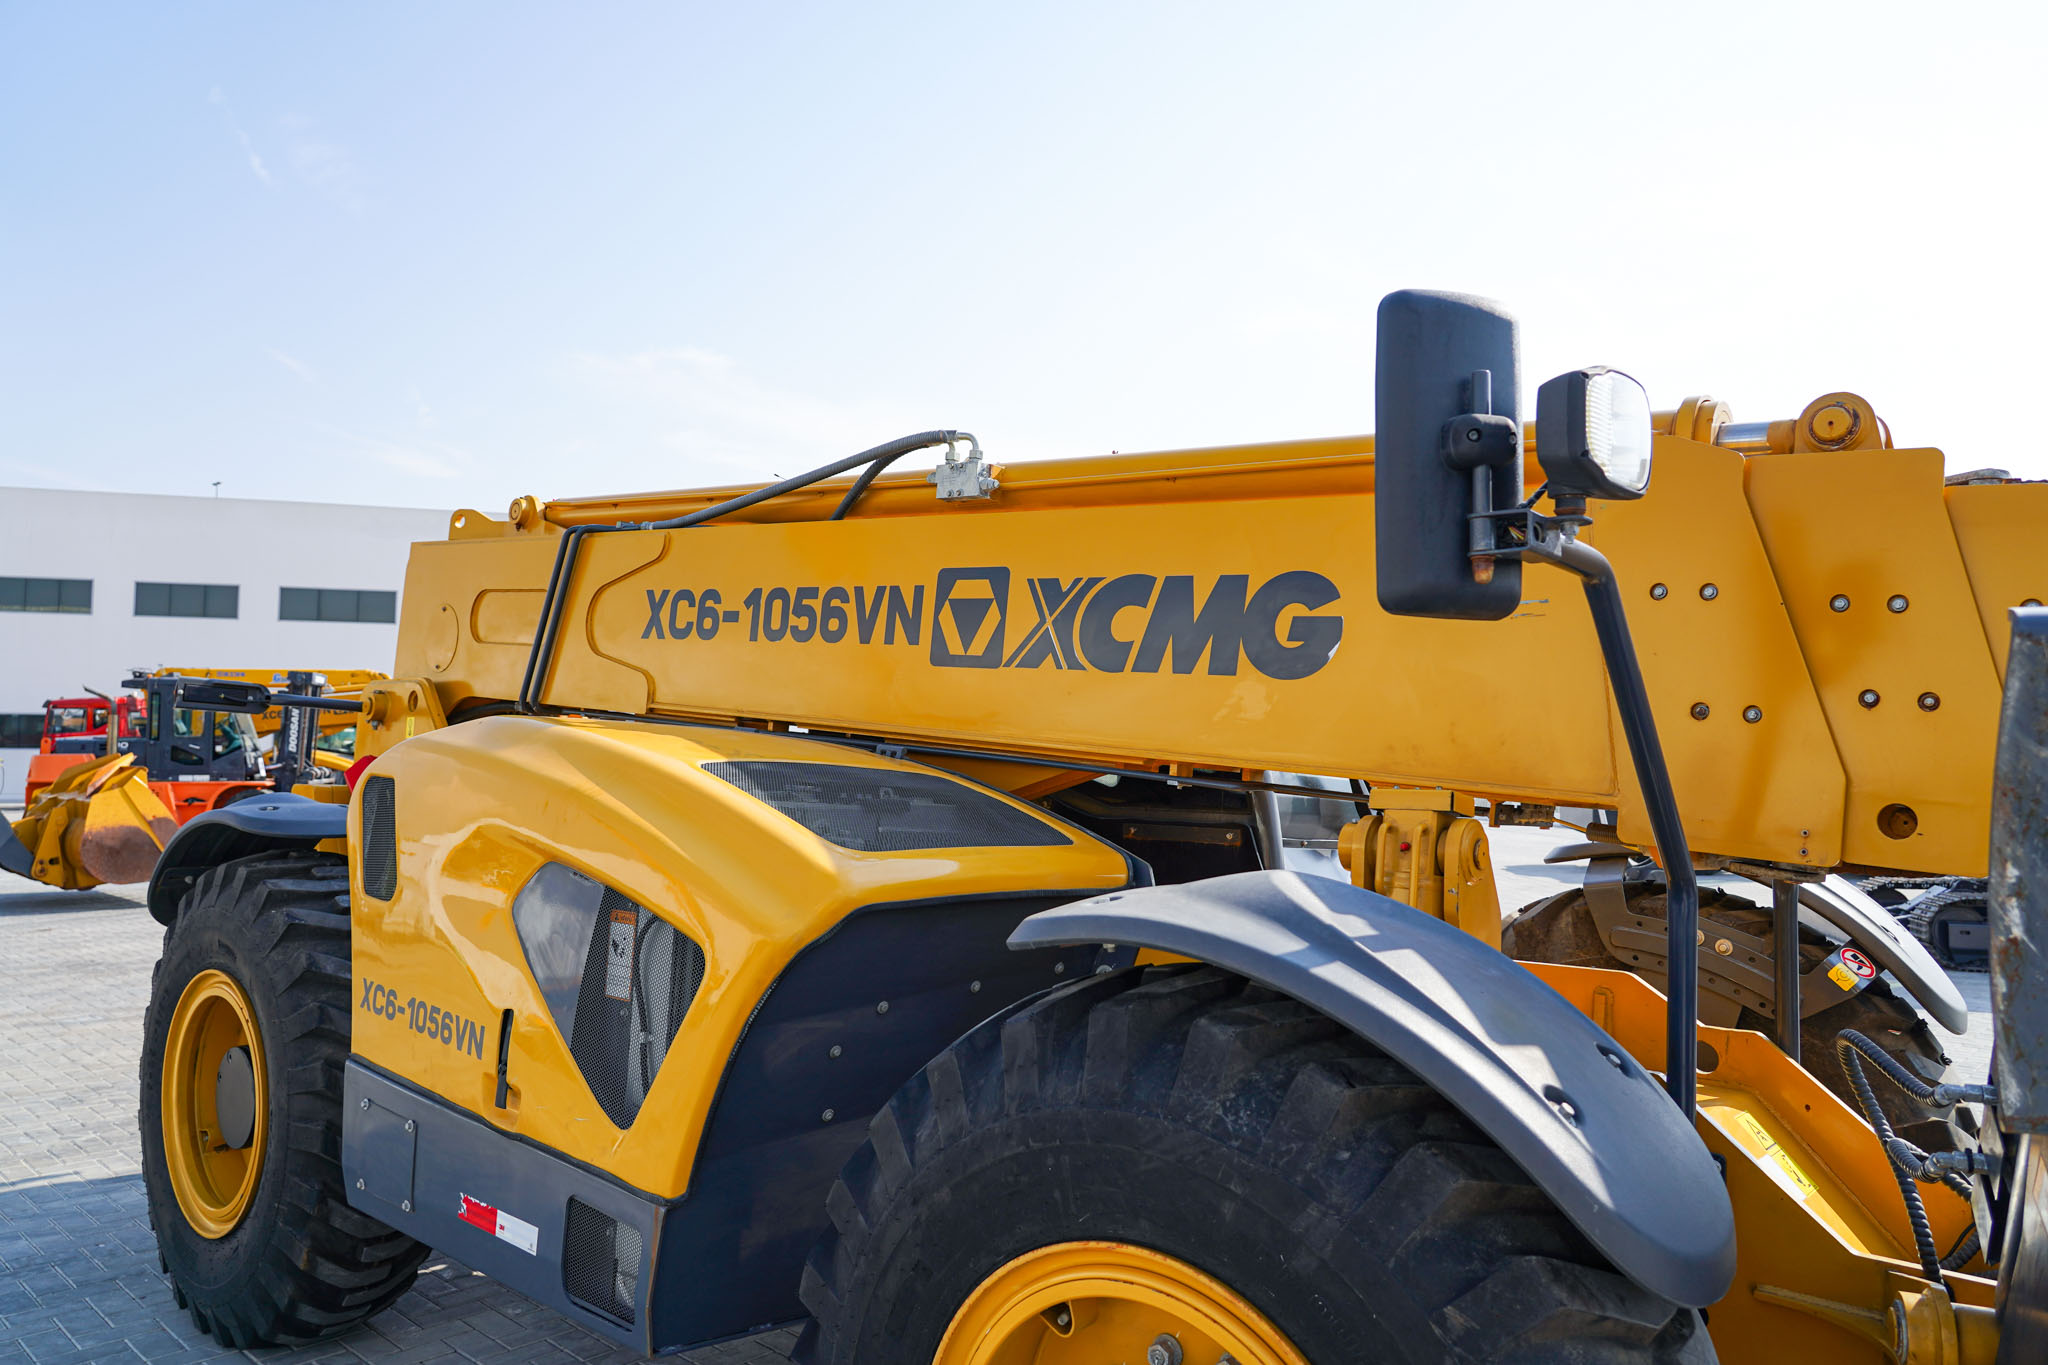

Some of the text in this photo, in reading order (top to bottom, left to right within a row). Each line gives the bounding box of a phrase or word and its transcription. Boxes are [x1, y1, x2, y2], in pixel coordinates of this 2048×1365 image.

[641, 570, 1344, 680] XC6-1056VN XCMG
[288, 708, 300, 752] DOOSAN
[360, 977, 486, 1060] XC6-1056VN
